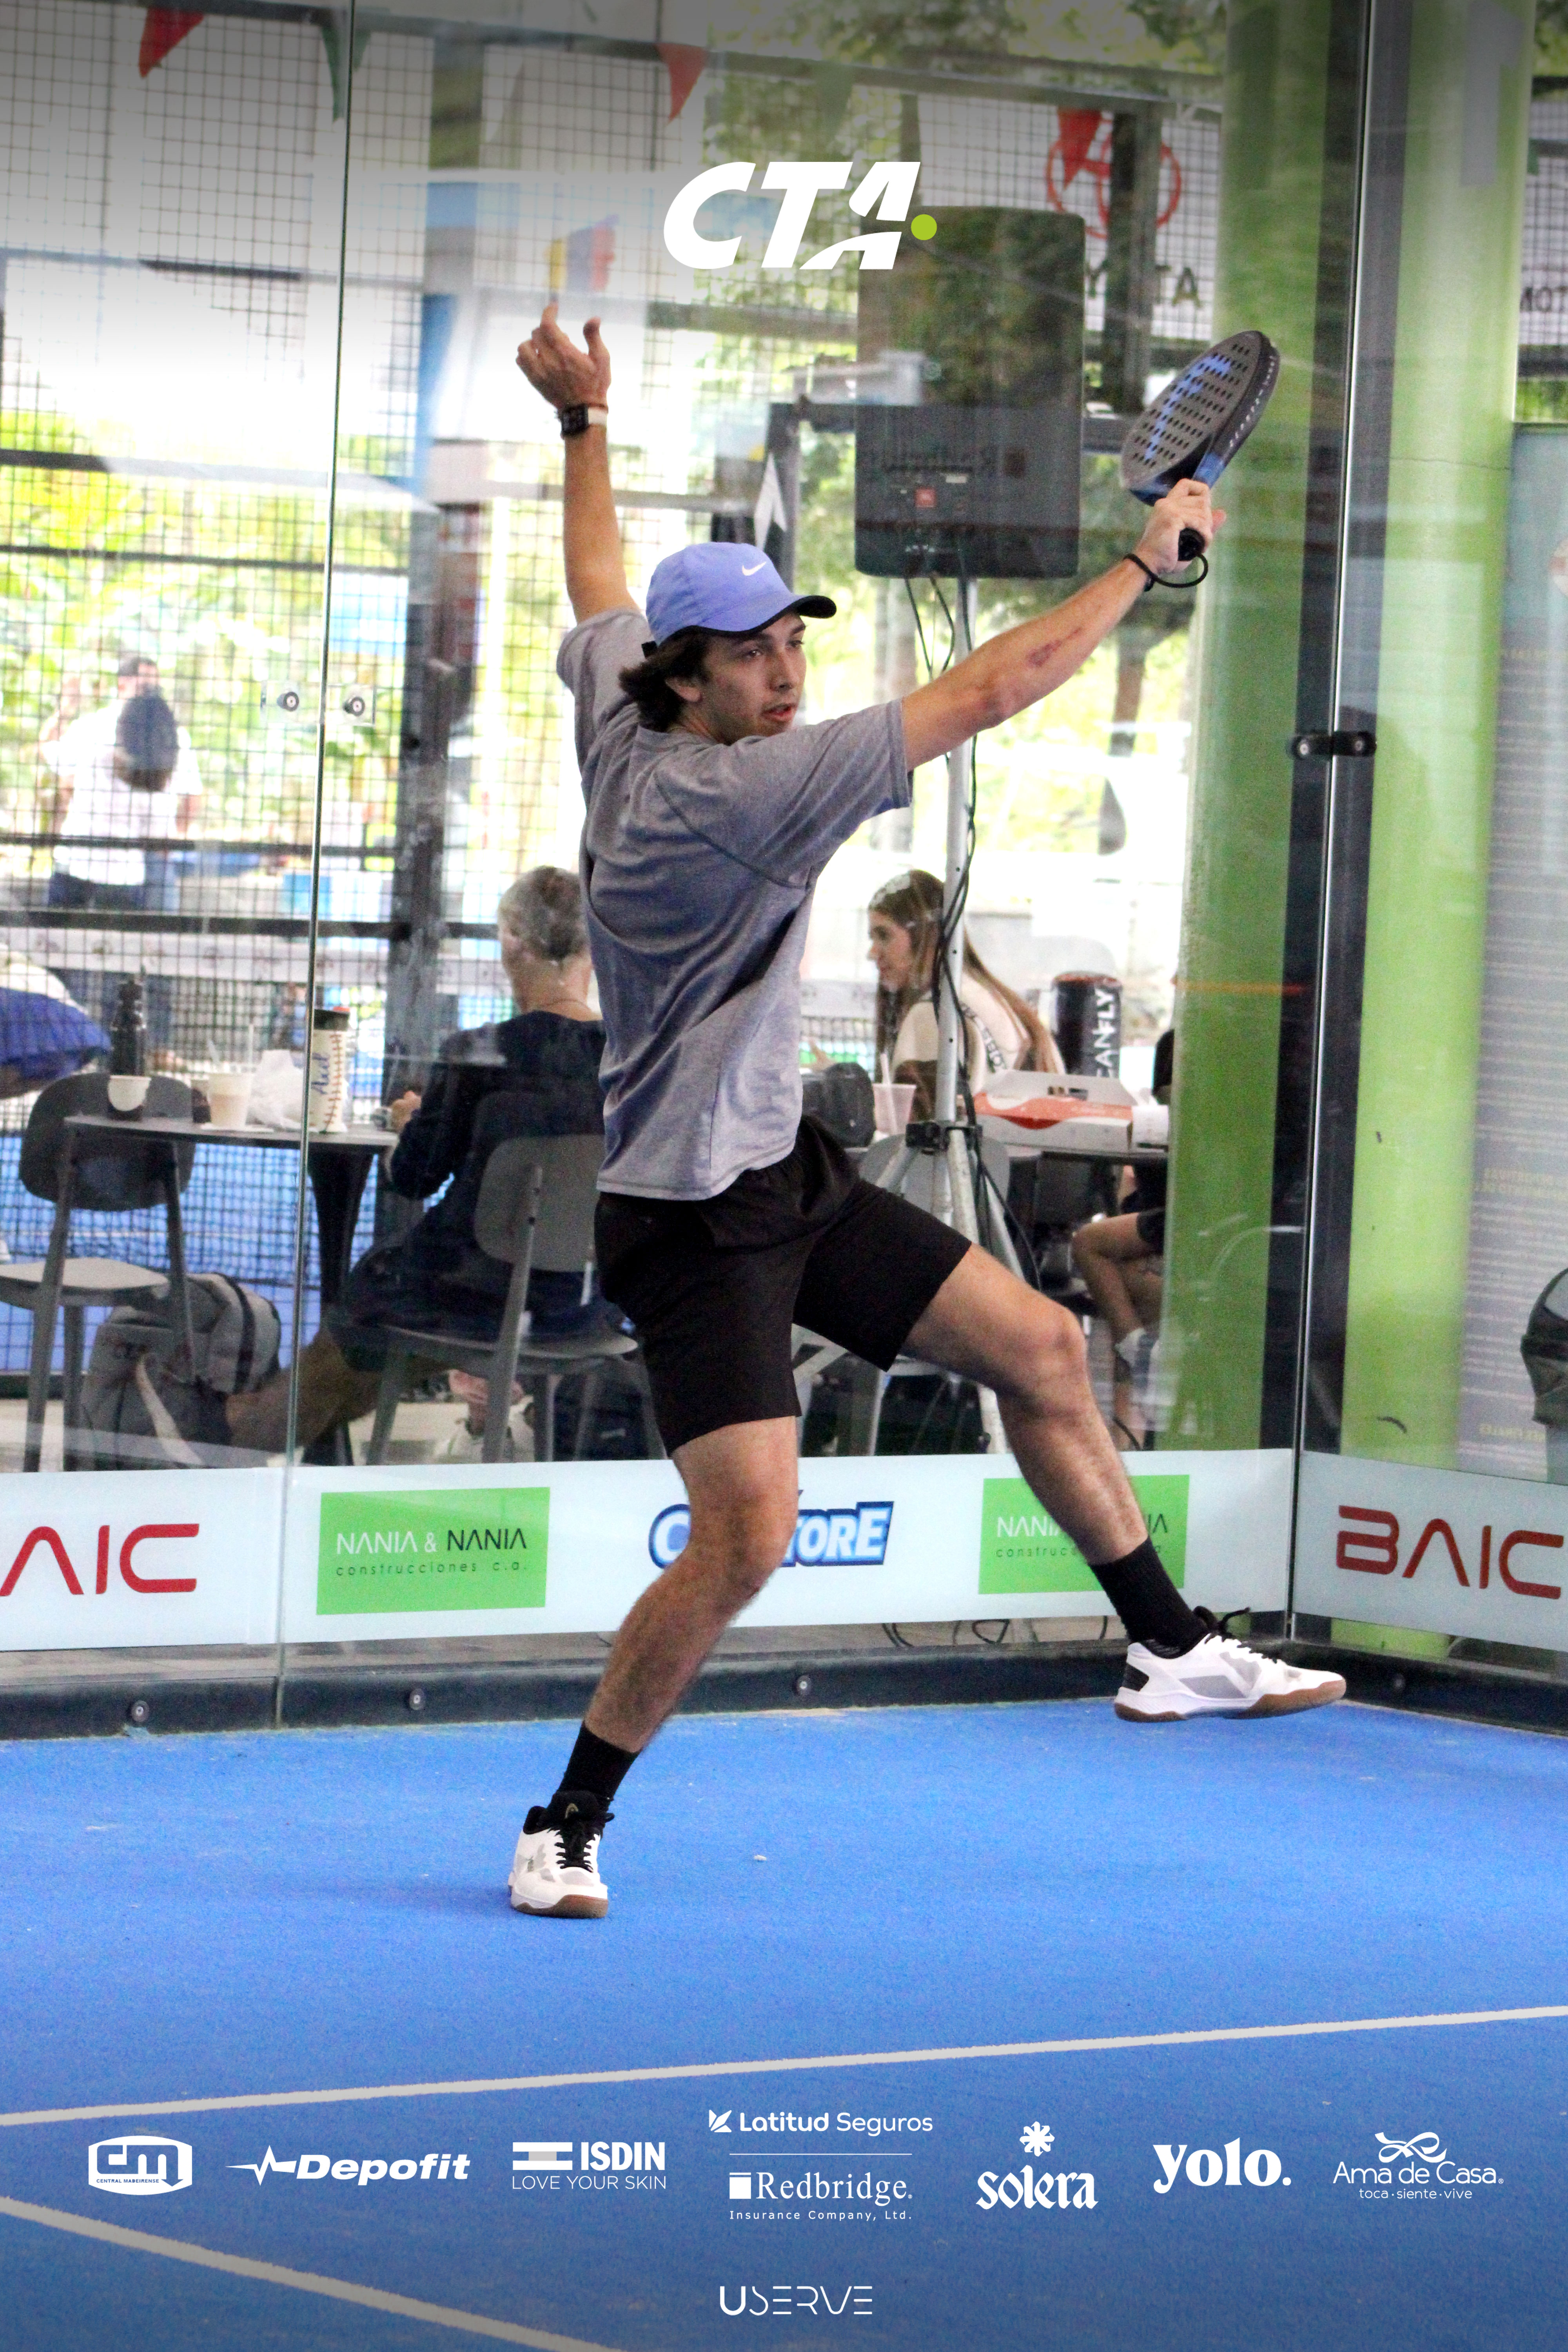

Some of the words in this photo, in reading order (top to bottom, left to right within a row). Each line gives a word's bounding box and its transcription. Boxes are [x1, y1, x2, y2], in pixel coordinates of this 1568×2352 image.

[336, 1531, 418, 1554] NANIA
[425, 1532, 437, 1553] &
[447, 1528, 527, 1551] NANIA
[1336, 1505, 1564, 1599] BAIC
[336, 1561, 477, 1576] construcciones
